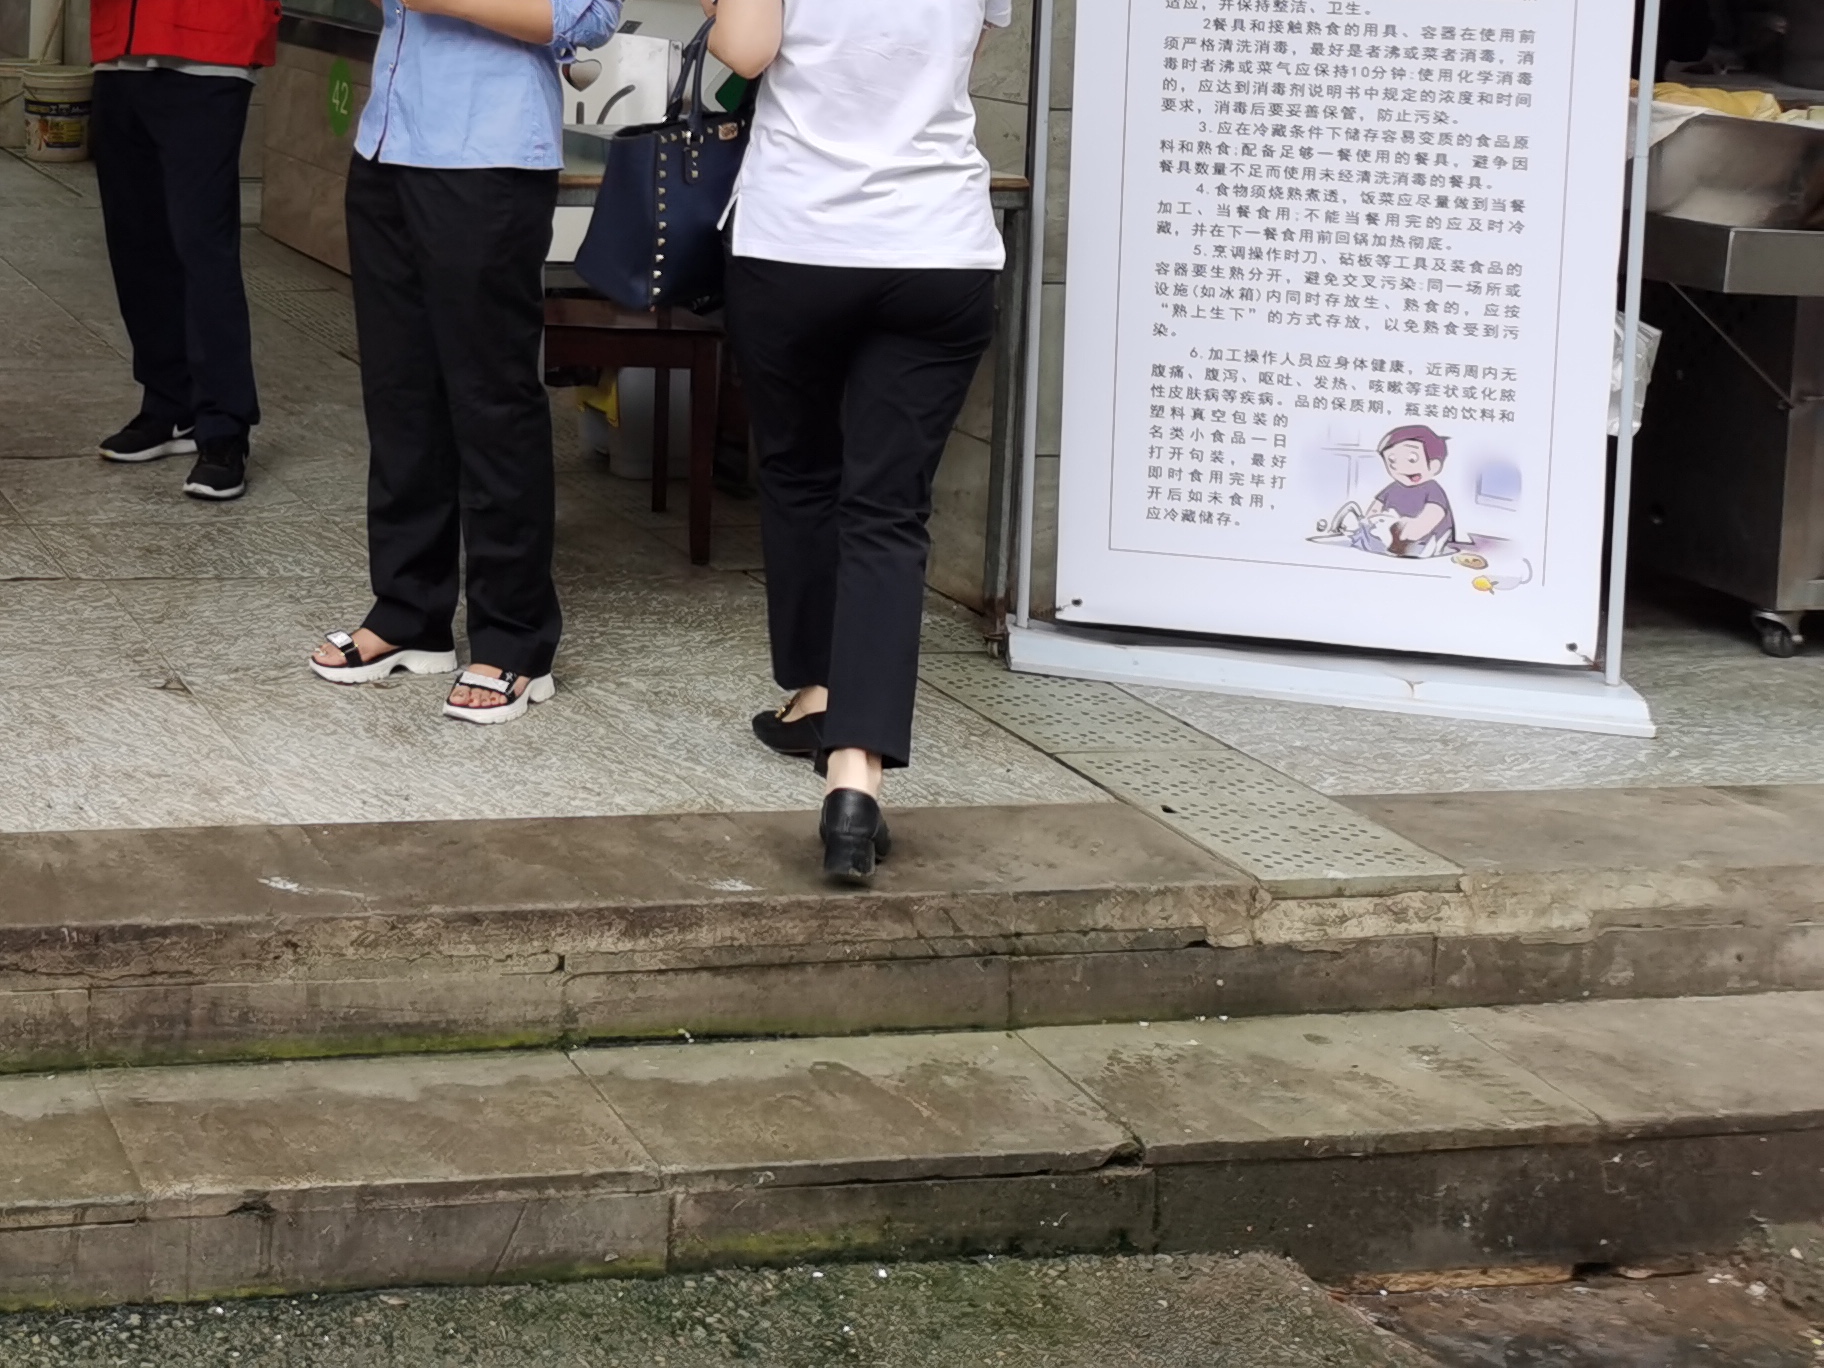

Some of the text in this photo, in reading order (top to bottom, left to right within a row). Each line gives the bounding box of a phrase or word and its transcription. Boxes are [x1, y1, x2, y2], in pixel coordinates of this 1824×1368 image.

[331, 79, 349, 116] 42
[1152, 322, 1178, 339] 染。
[1146, 464, 1287, 490] 即时食用完毕打
[1145, 505, 1243, 528] 应冷藏储存。
